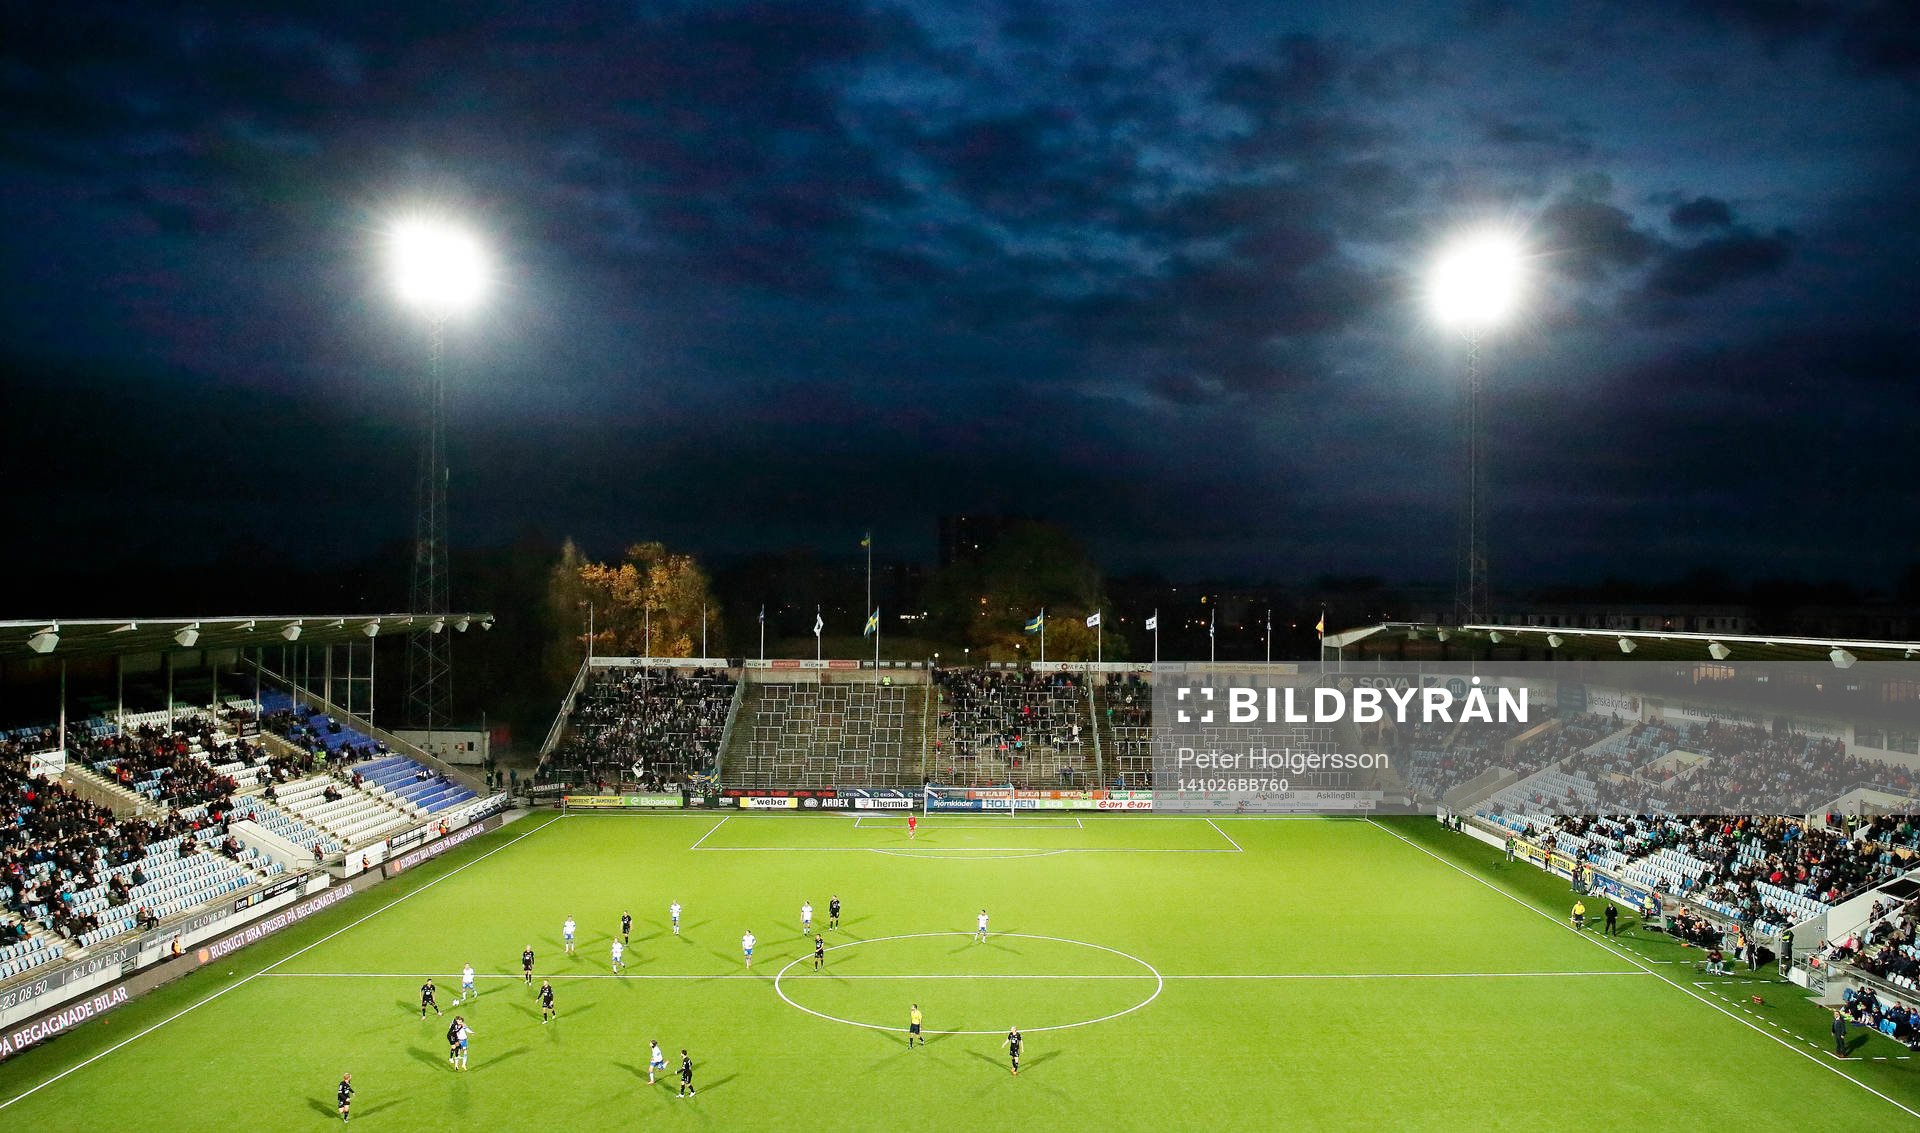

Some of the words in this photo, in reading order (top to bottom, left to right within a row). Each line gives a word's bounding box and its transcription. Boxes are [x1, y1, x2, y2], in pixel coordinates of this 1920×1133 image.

[1359, 677, 1410, 690] SOVA
[1256, 792, 1295, 800] AklingBil
[757, 798, 787, 806] weber
[822, 799, 849, 808] ARDEX
[872, 799, 909, 808] Thermia
[985, 800, 1035, 808] HOLMEN
[245, 918, 263, 943] BRA
[72, 948, 128, 981] KLÖVERN
[19, 986, 32, 1003] 08
[34, 979, 48, 997] 50
[13, 1001, 95, 1050] BEGAGNADE
[93, 986, 129, 1013] BILAR
